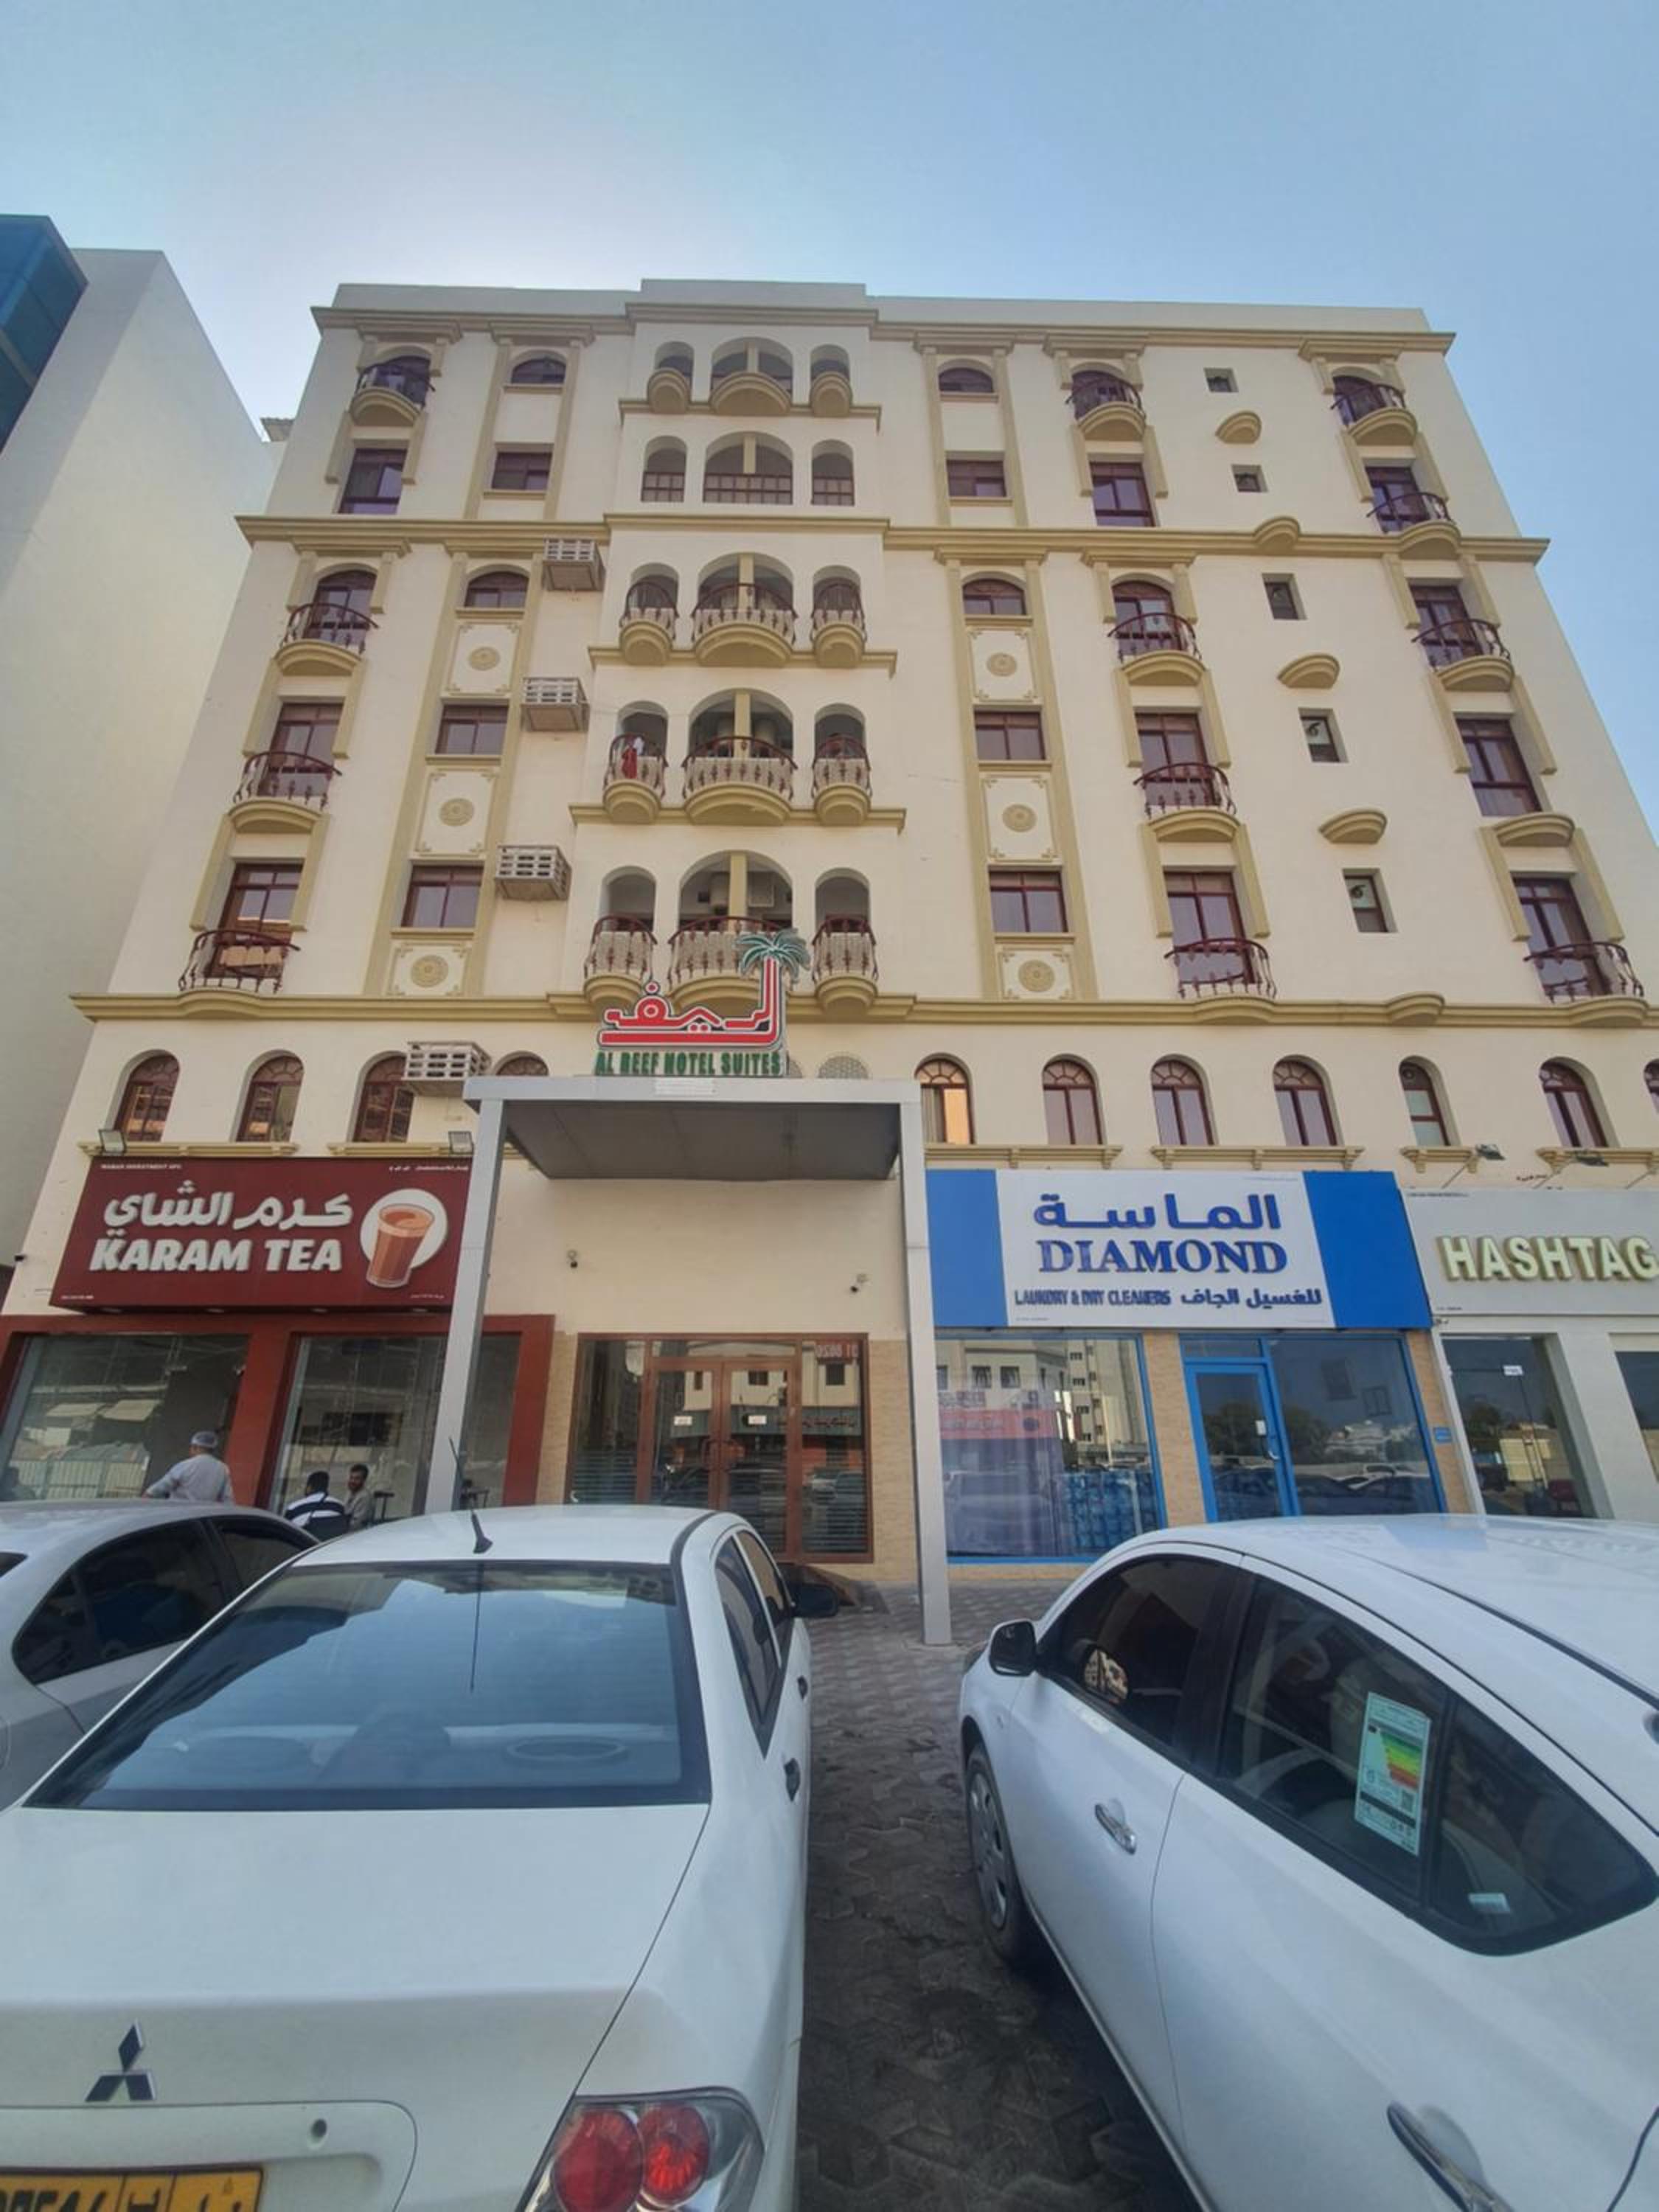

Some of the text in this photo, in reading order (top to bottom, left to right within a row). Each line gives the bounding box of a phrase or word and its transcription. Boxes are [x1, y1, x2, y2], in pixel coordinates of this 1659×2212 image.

[594, 1051, 781, 1075] AL REEF HOTEL SUITES
[103, 1180, 354, 1237] كرم الشاي
[1034, 1193, 1282, 1230] الماسة
[88, 1239, 344, 1272] KARAM TEA
[1037, 1239, 1288, 1274] DIAMOND
[1438, 1234, 1659, 1281] HASHTAG
[1015, 1290, 1172, 1306] LAUNDRY & DRY CLEANERS
[1180, 1288, 1323, 1310] للغسيل الجاف
